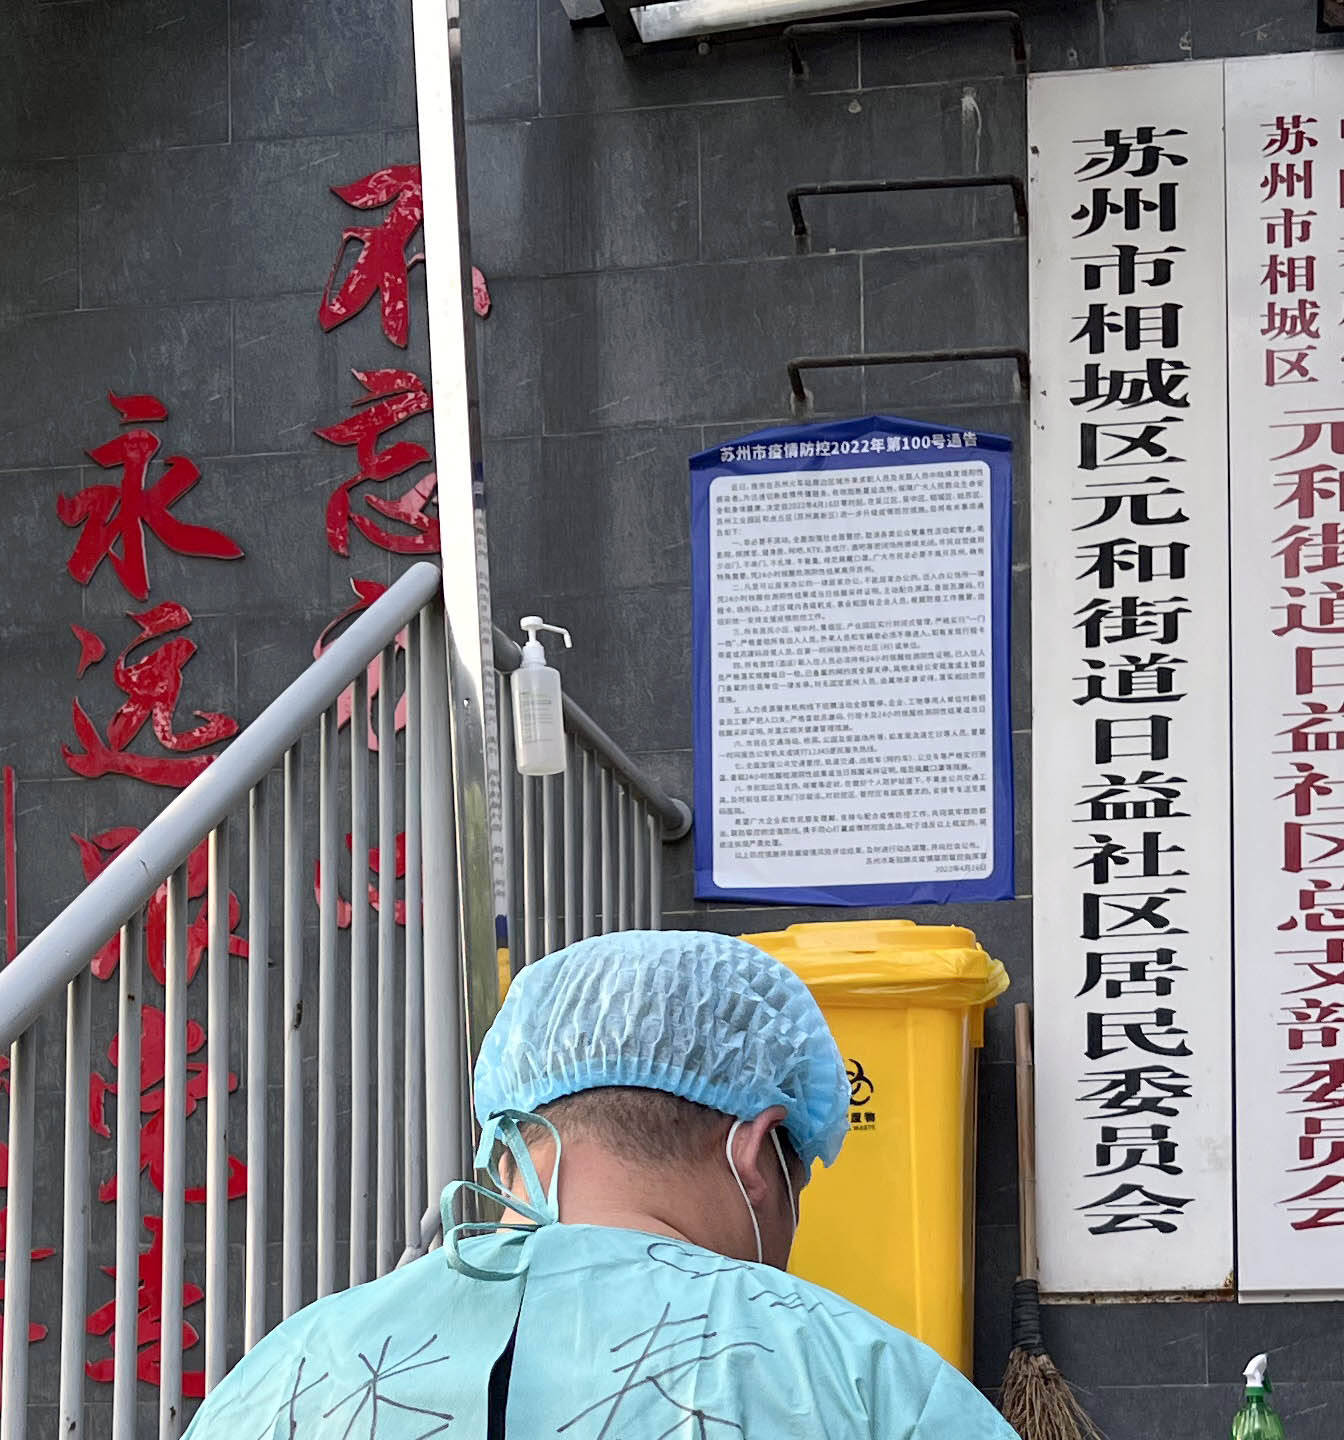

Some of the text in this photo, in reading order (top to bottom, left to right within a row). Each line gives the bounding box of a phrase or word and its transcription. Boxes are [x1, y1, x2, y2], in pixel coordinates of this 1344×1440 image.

[1260, 115, 1321, 387] 苏州市相城区
[720, 432, 978, 463] 苏州市疫情防控2022年第100号通告
[1069, 126, 1197, 1236] 苏州市相城区元和街道日益社区居民委员会
